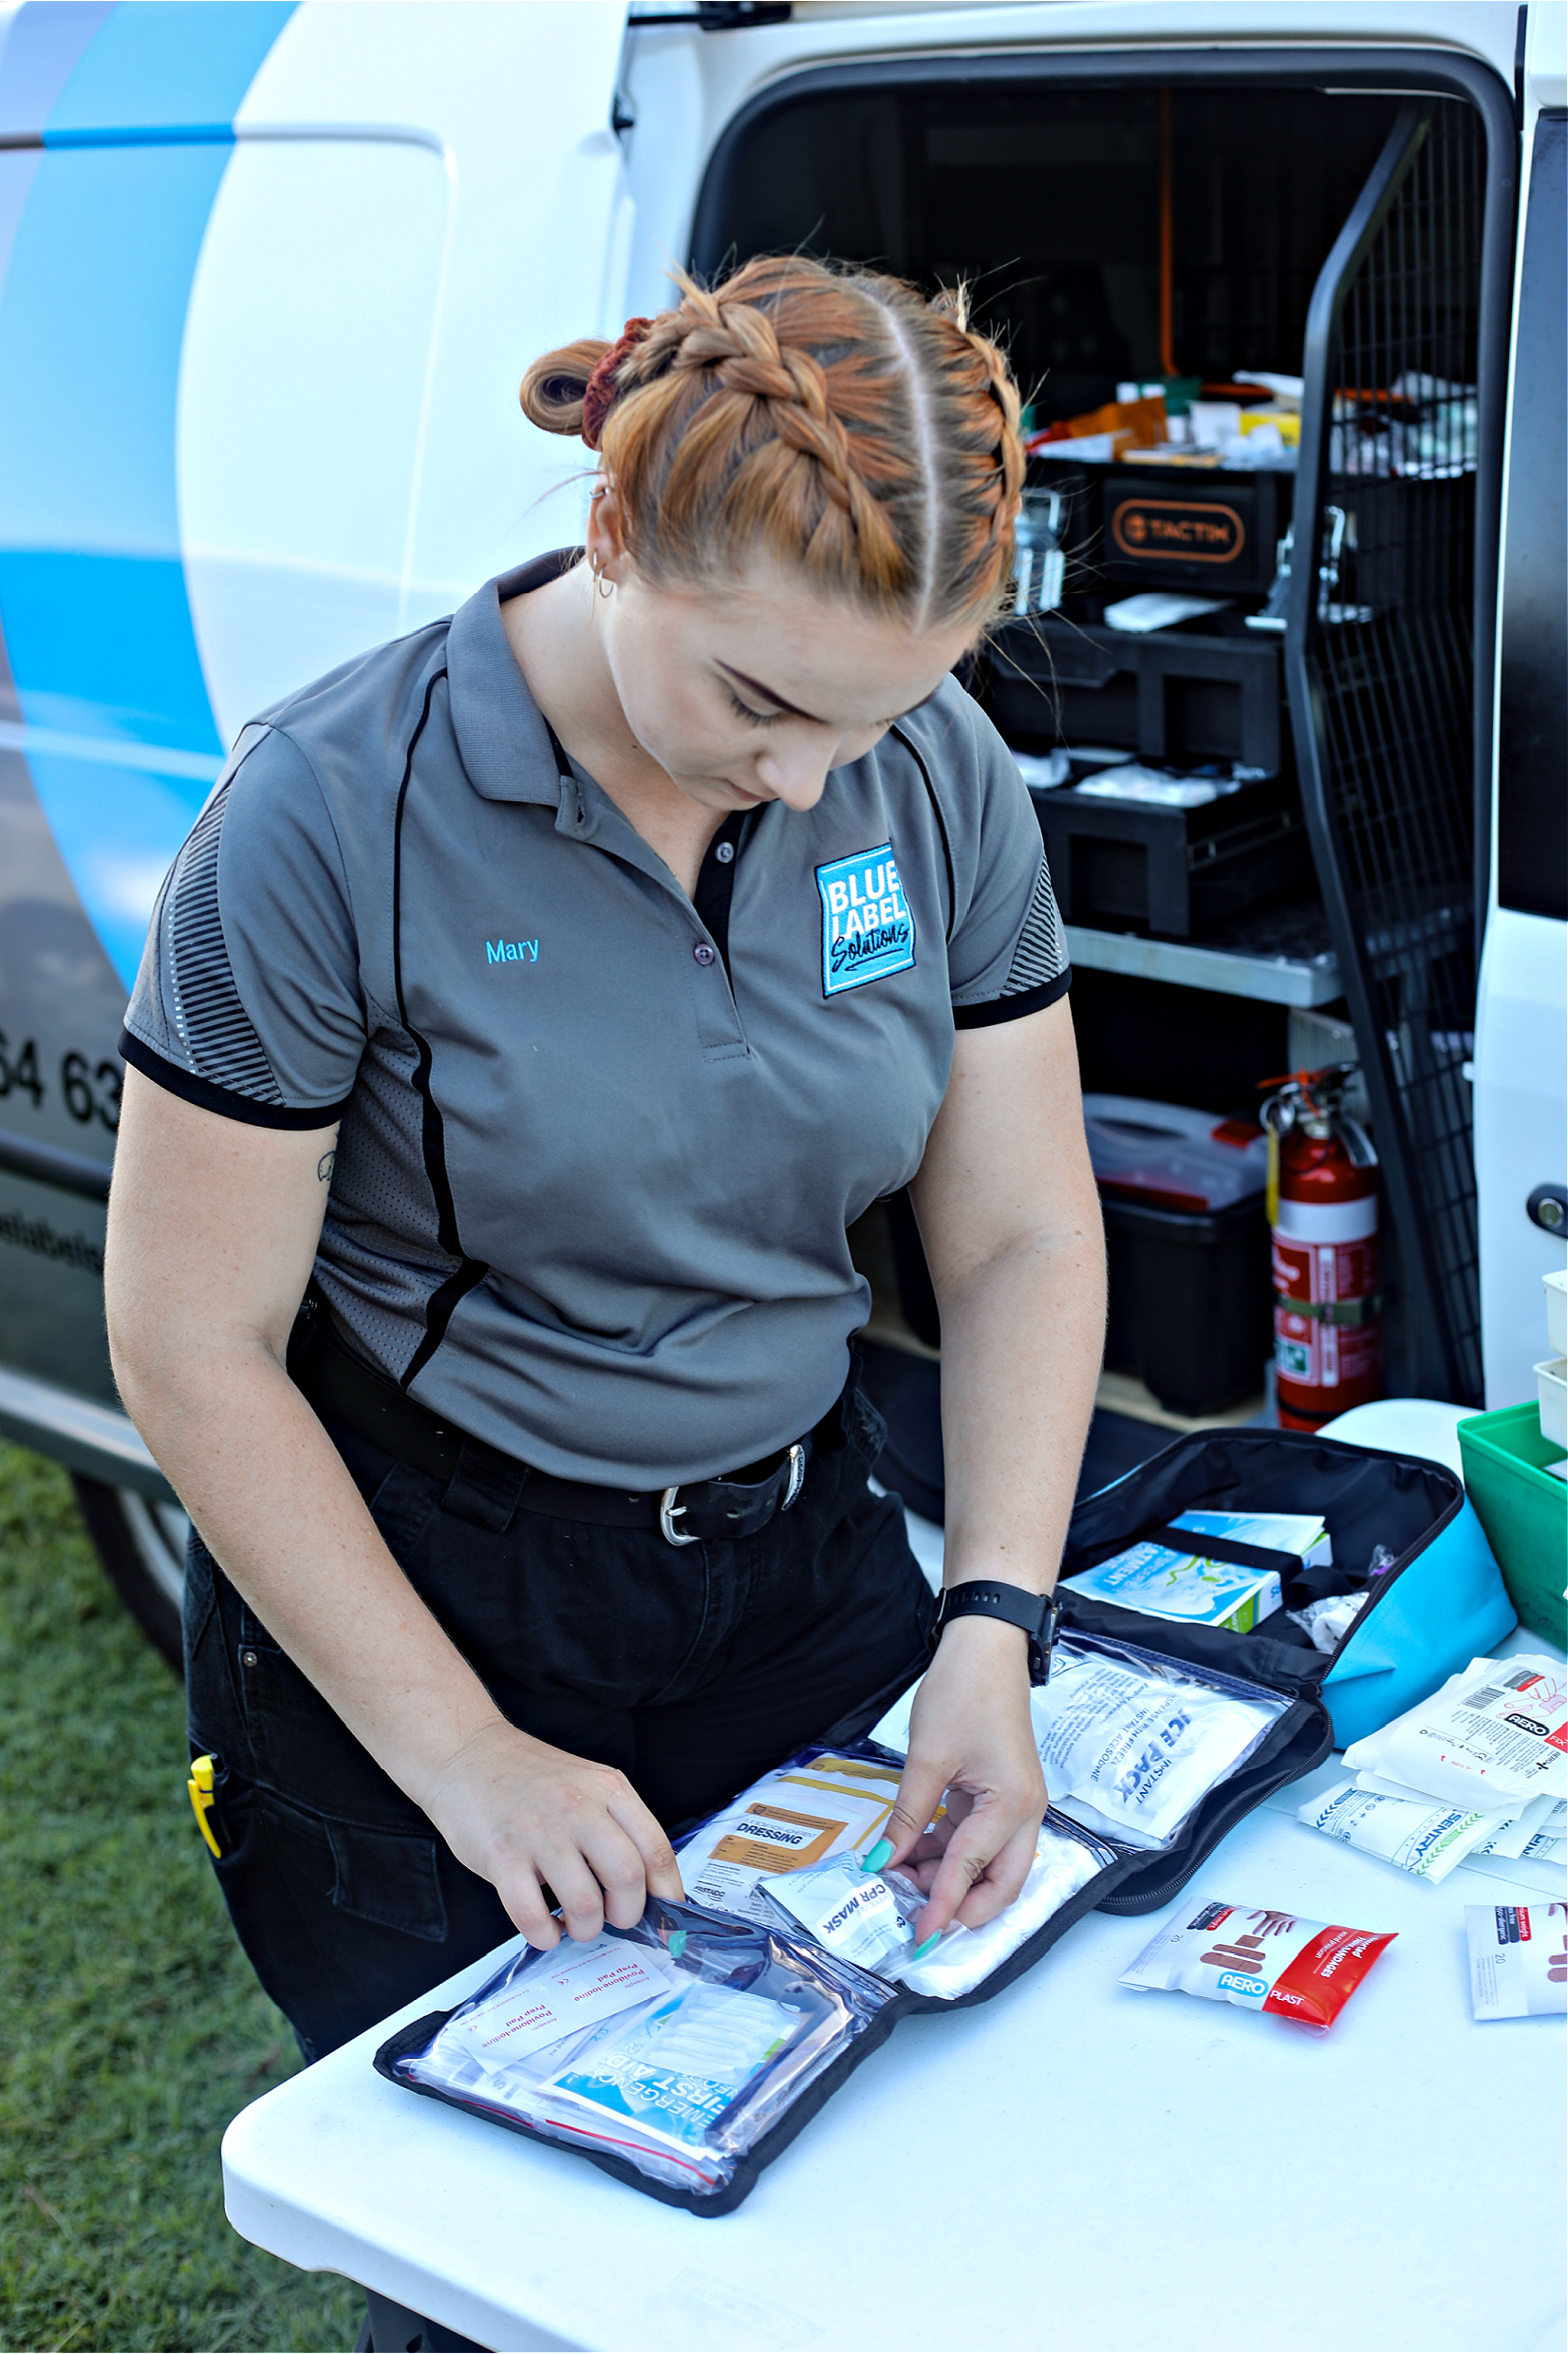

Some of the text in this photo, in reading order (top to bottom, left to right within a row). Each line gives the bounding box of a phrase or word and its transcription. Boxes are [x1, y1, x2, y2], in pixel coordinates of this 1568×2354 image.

[828, 860, 901, 915] BLUE
[831, 892, 906, 943] LABEL
[485, 938, 540, 965] Mary
[831, 923, 910, 973] Solutions
[62, 1051, 123, 1135] 63
[1131, 1722, 1150, 1738] WITH
[1507, 1714, 1548, 1736] AERO
[1091, 1732, 1124, 1783] ACESODYNE
[1113, 1708, 1193, 1803] ICE PACK
[1135, 1759, 1172, 1804] INSTANT
[737, 1822, 804, 1845] DRESSING
[1414, 1812, 1463, 1858] SENTRY
[822, 1884, 886, 1934] CPR MASK
[596, 1961, 637, 1983] Prep Pad
[1495, 1952, 1505, 1964] 20
[572, 1967, 644, 2003] Povidone-Iodine
[1221, 1974, 1305, 2006] AERO PLAST
[480, 2008, 551, 2049] Povidone-Iodine
[505, 2003, 546, 2027] Prep Pad
[605, 2054, 658, 2081] AID
[591, 2066, 716, 2129] EMERGENCY
[652, 2075, 726, 2116] FIRST
